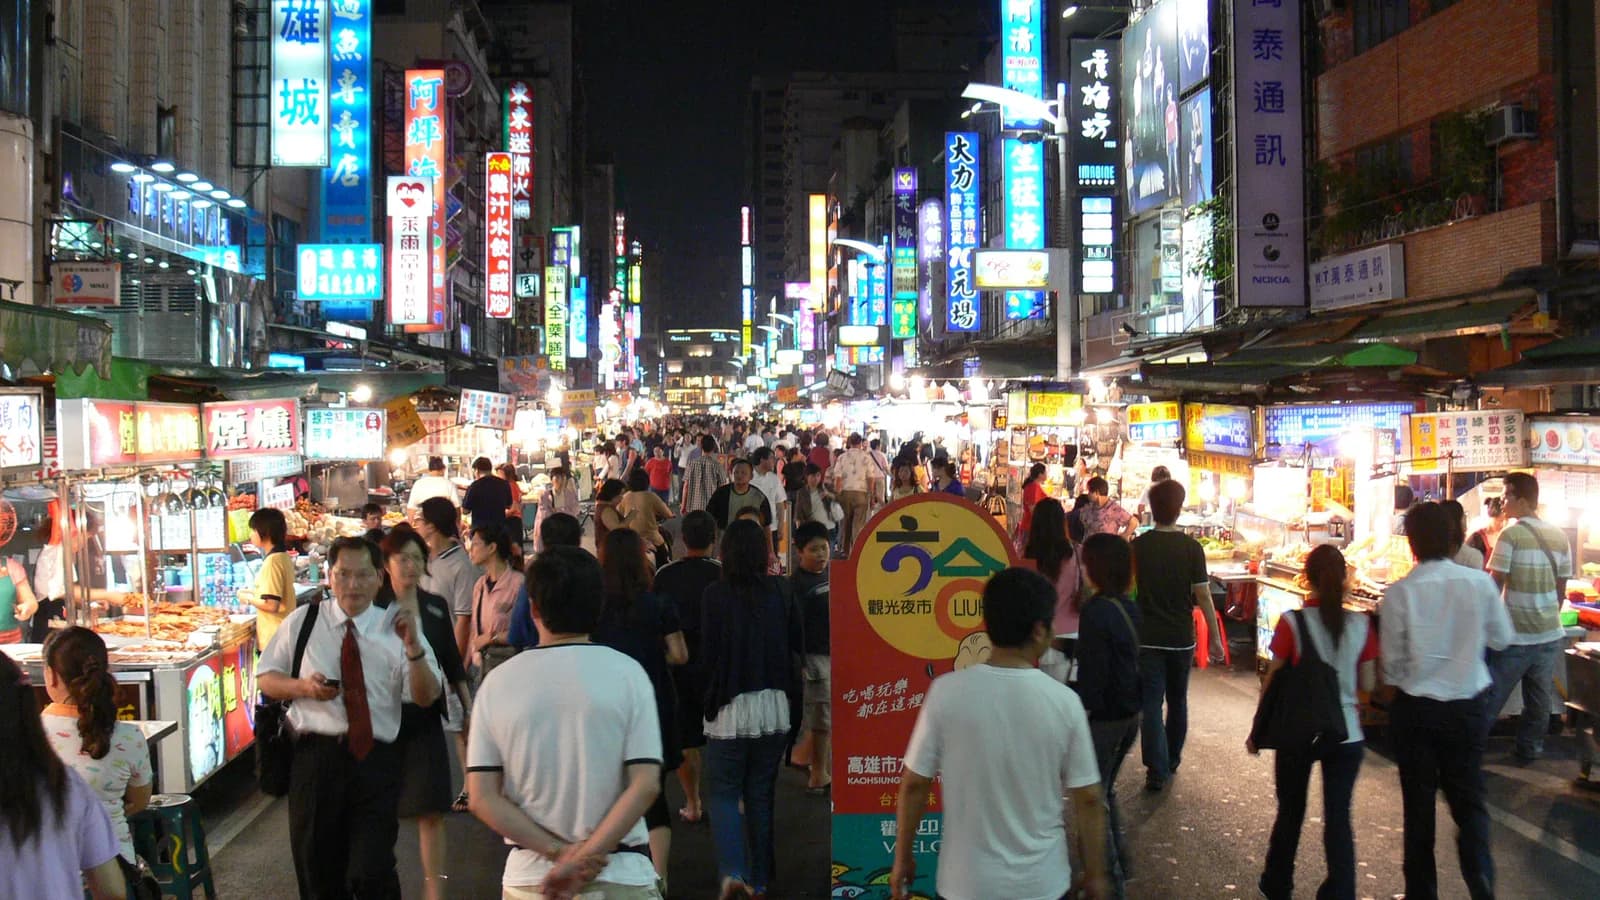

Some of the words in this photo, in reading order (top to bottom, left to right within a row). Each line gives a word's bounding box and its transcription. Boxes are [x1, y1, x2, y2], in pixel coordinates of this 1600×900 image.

[1251, 0, 1286, 167] 泰通訊
[950, 135, 976, 190] 大力
[1010, 144, 1041, 246] 生猛海
[1252, 276, 1291, 285] NOKIA
[868, 600, 933, 616] 觀光夜市
[842, 677, 909, 704] 吃喝玩樂
[856, 692, 925, 720] 都在這裡
[847, 776, 901, 785] KAOHSIUNG
